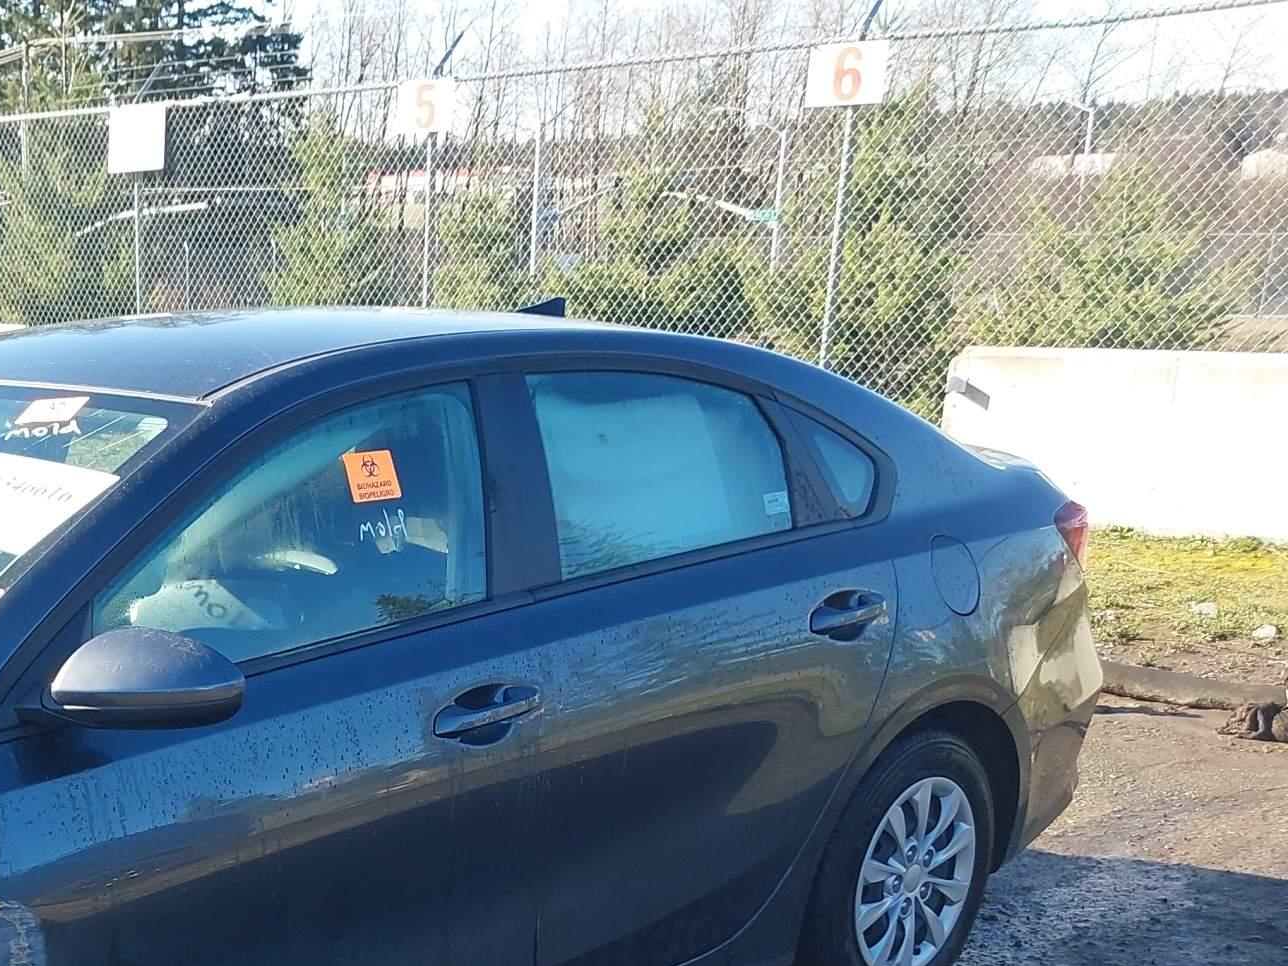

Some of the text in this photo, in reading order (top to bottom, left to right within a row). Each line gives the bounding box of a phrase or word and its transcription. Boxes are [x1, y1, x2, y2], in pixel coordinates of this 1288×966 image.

[833, 46, 863, 101] 6
[415, 84, 436, 129] 5
[357, 480, 392, 490] BIOHAZARD
[359, 489, 394, 499] BIOPELIGRO
